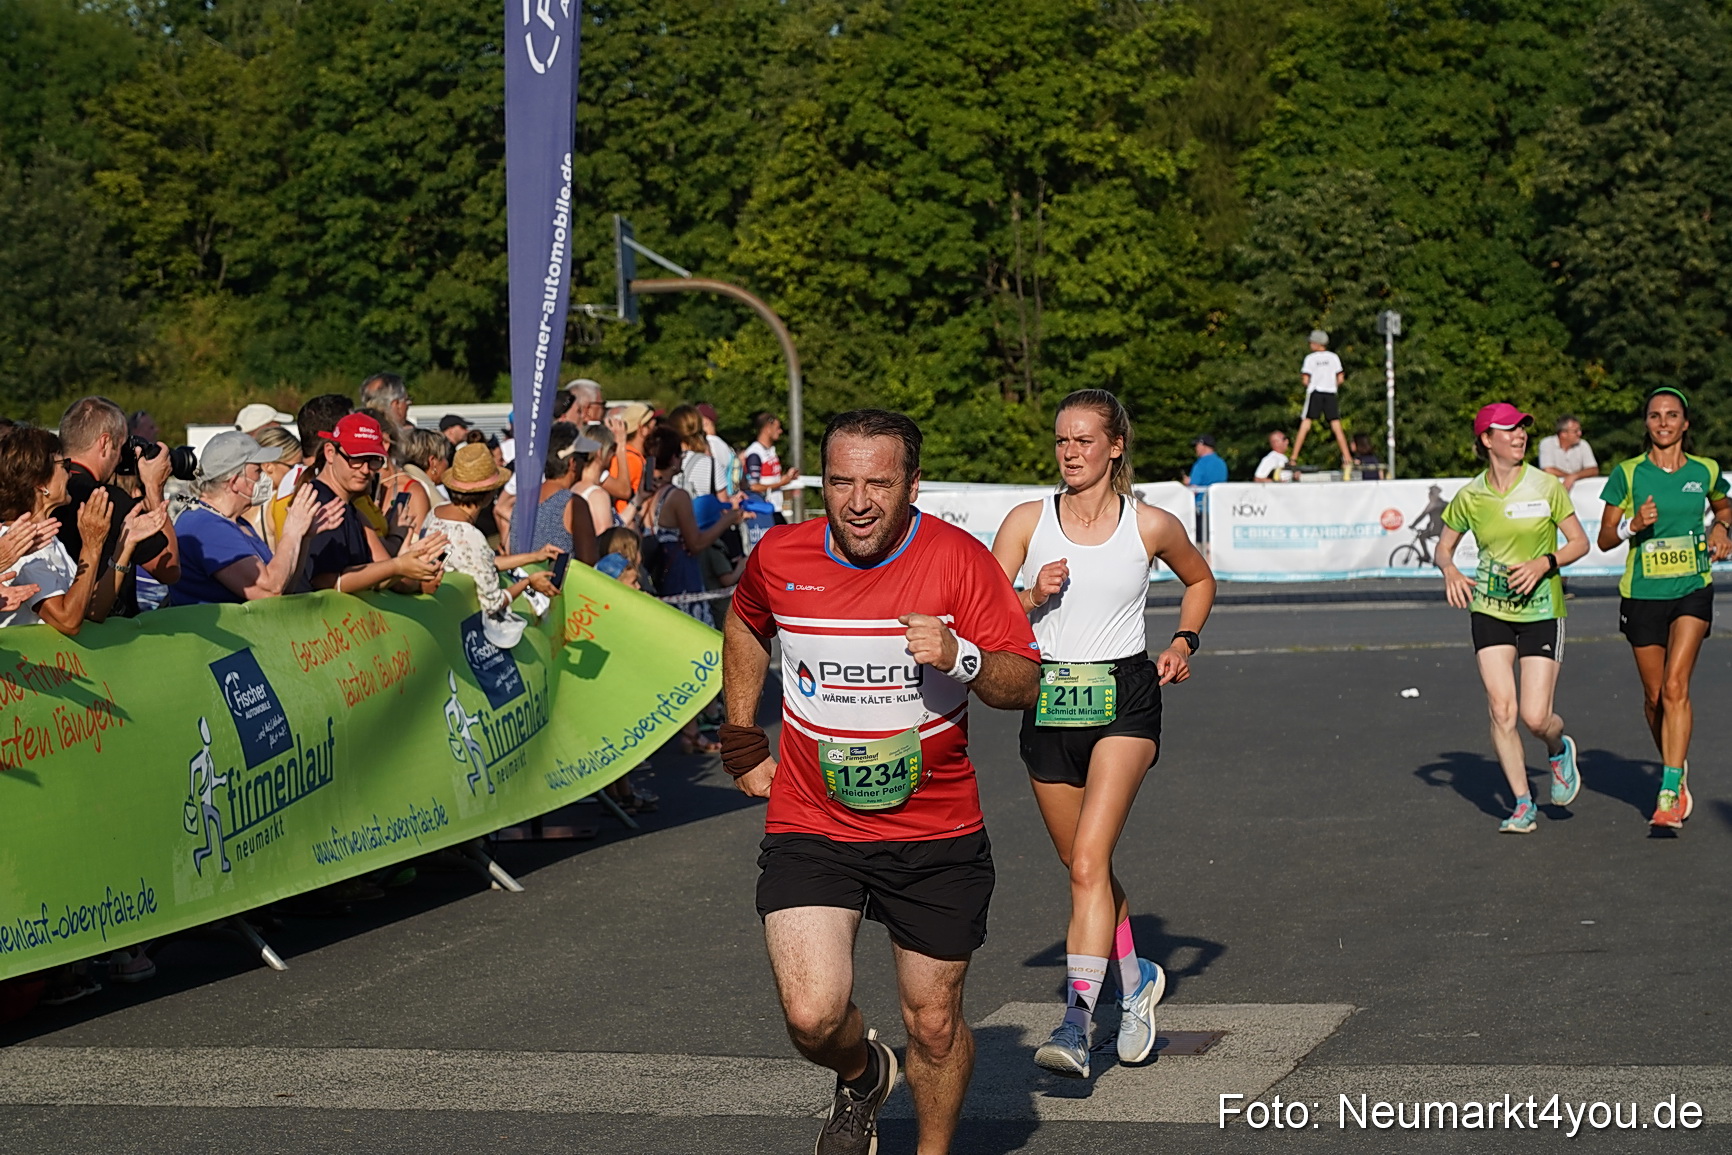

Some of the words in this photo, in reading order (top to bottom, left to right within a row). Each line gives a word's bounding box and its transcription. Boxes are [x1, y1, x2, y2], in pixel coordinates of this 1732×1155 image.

[935, 509, 969, 523] OW
[1232, 503, 1267, 517] NOW
[1651, 550, 1688, 566] 1986
[291, 618, 351, 672] Gesunde
[16, 651, 88, 696] Firmen
[818, 661, 924, 689] Petry
[233, 683, 268, 711] Fischer
[1040, 692, 1048, 714] RUN
[1053, 686, 1093, 706] 211
[1104, 688, 1113, 717] 2022
[245, 700, 272, 720] AUTOMOBILE
[1047, 707, 1077, 715] Schmidt
[1078, 707, 1105, 715] Miriam
[0, 715, 54, 772] ufen
[52, 681, 124, 754] länger!
[845, 752, 879, 761] Firmenlauf
[227, 716, 335, 832] firmenlauf
[825, 769, 837, 791] RUN
[837, 757, 909, 788] 1234
[909, 756, 918, 789] 2022
[841, 787, 880, 797] Heidner
[882, 783, 907, 795] Peter
[236, 815, 285, 862] neumarkt
